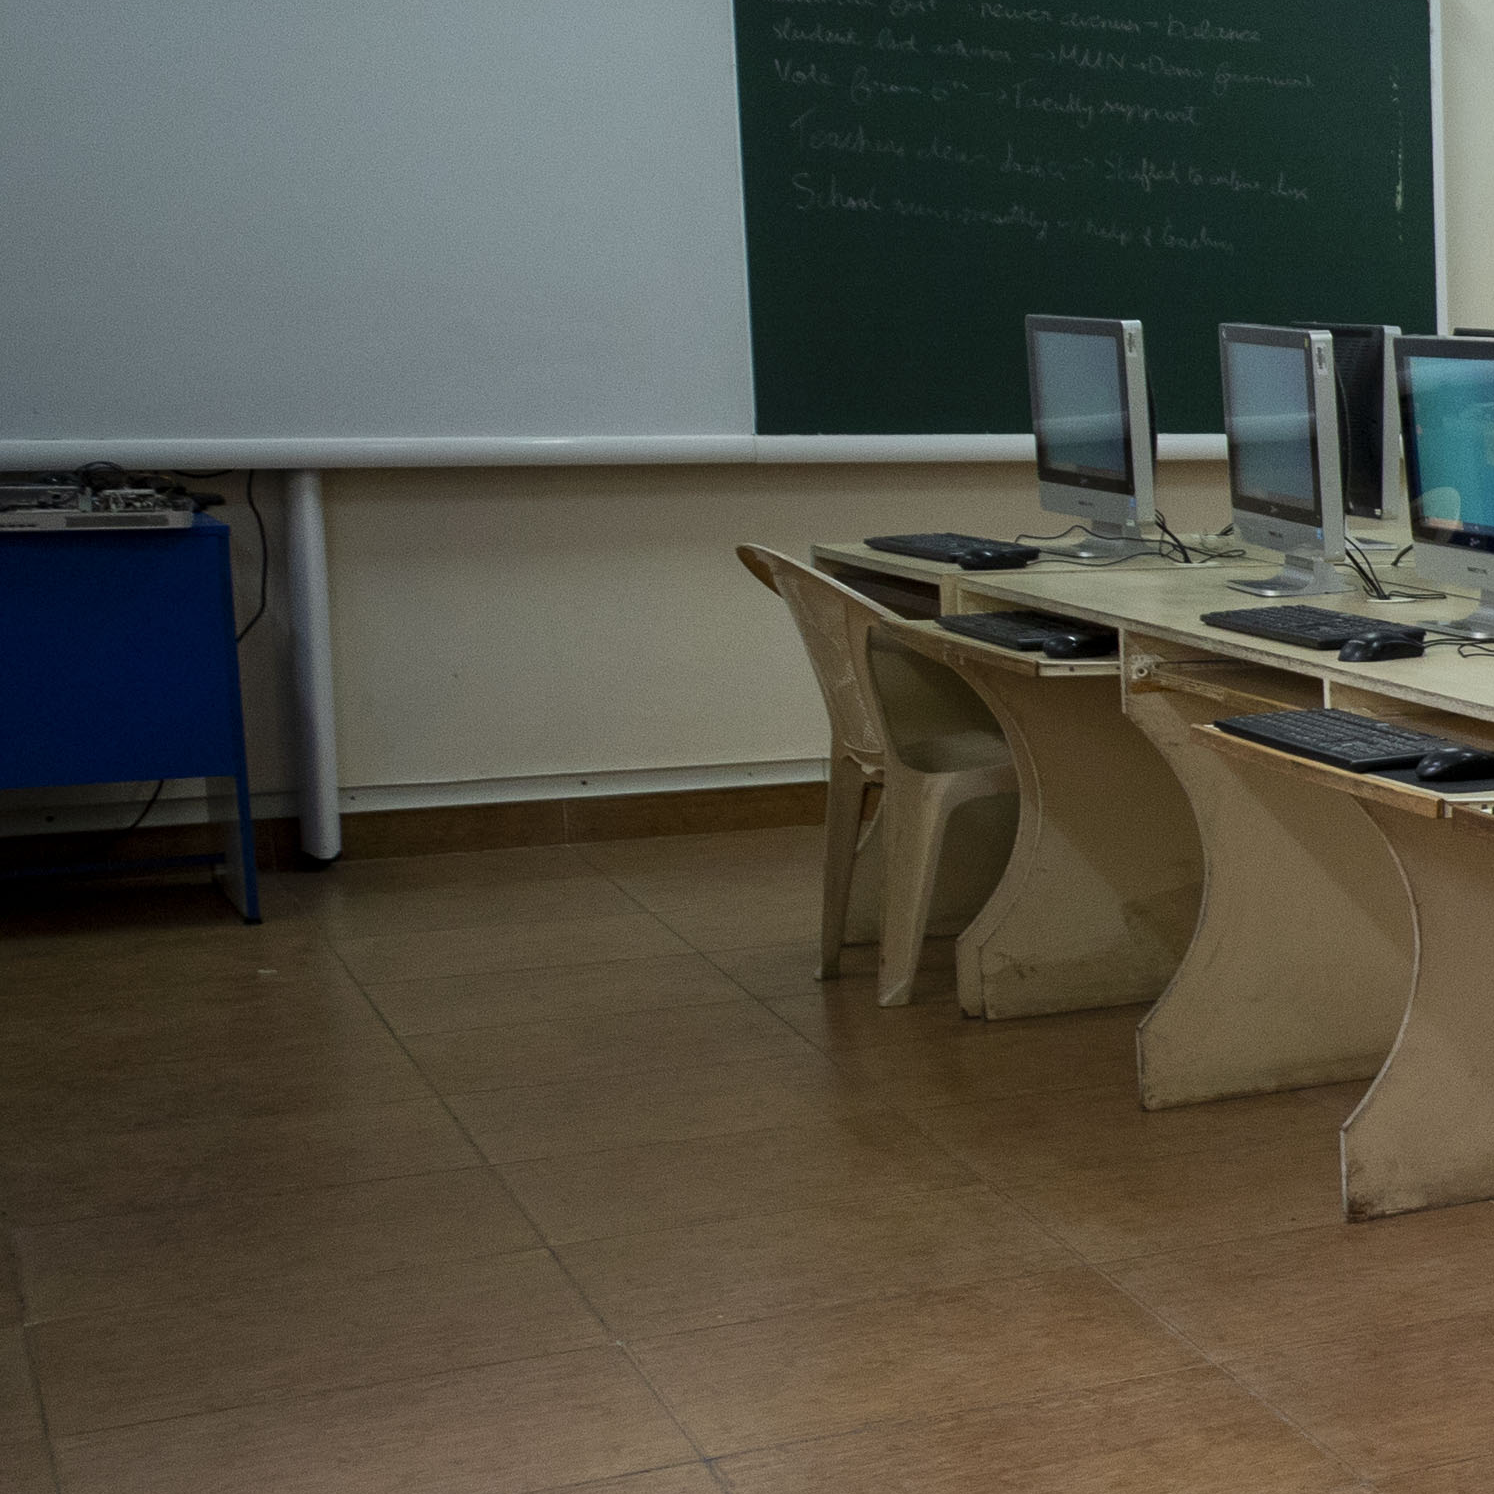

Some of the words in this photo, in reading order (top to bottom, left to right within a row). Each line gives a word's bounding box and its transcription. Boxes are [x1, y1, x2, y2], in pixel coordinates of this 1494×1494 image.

[980, 2, 1053, 22] newer
[774, 58, 834, 86] Vote
[791, 171, 882, 211] School
